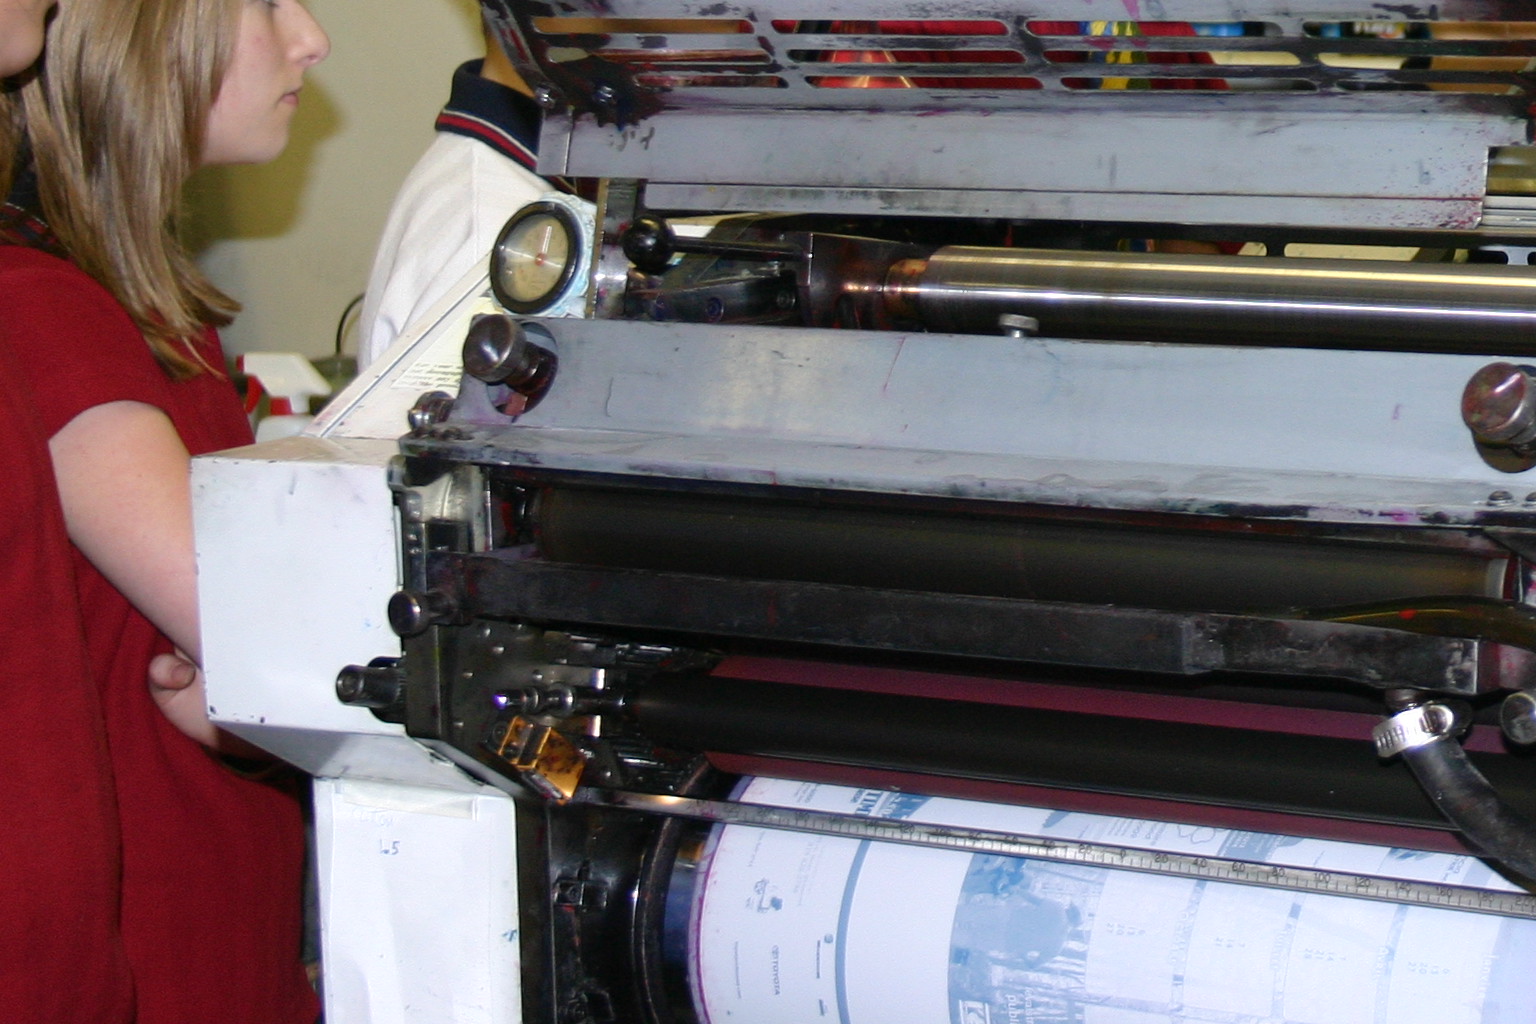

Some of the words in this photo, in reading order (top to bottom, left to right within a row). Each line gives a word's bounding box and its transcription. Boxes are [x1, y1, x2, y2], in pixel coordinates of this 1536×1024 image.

[1078, 843, 1093, 853] 20
[1154, 853, 1169, 863] 20
[1192, 857, 1207, 867] 40
[1232, 862, 1246, 872] 60
[1272, 866, 1286, 877] 80
[1313, 872, 1331, 883] 100
[1354, 876, 1371, 888] 120
